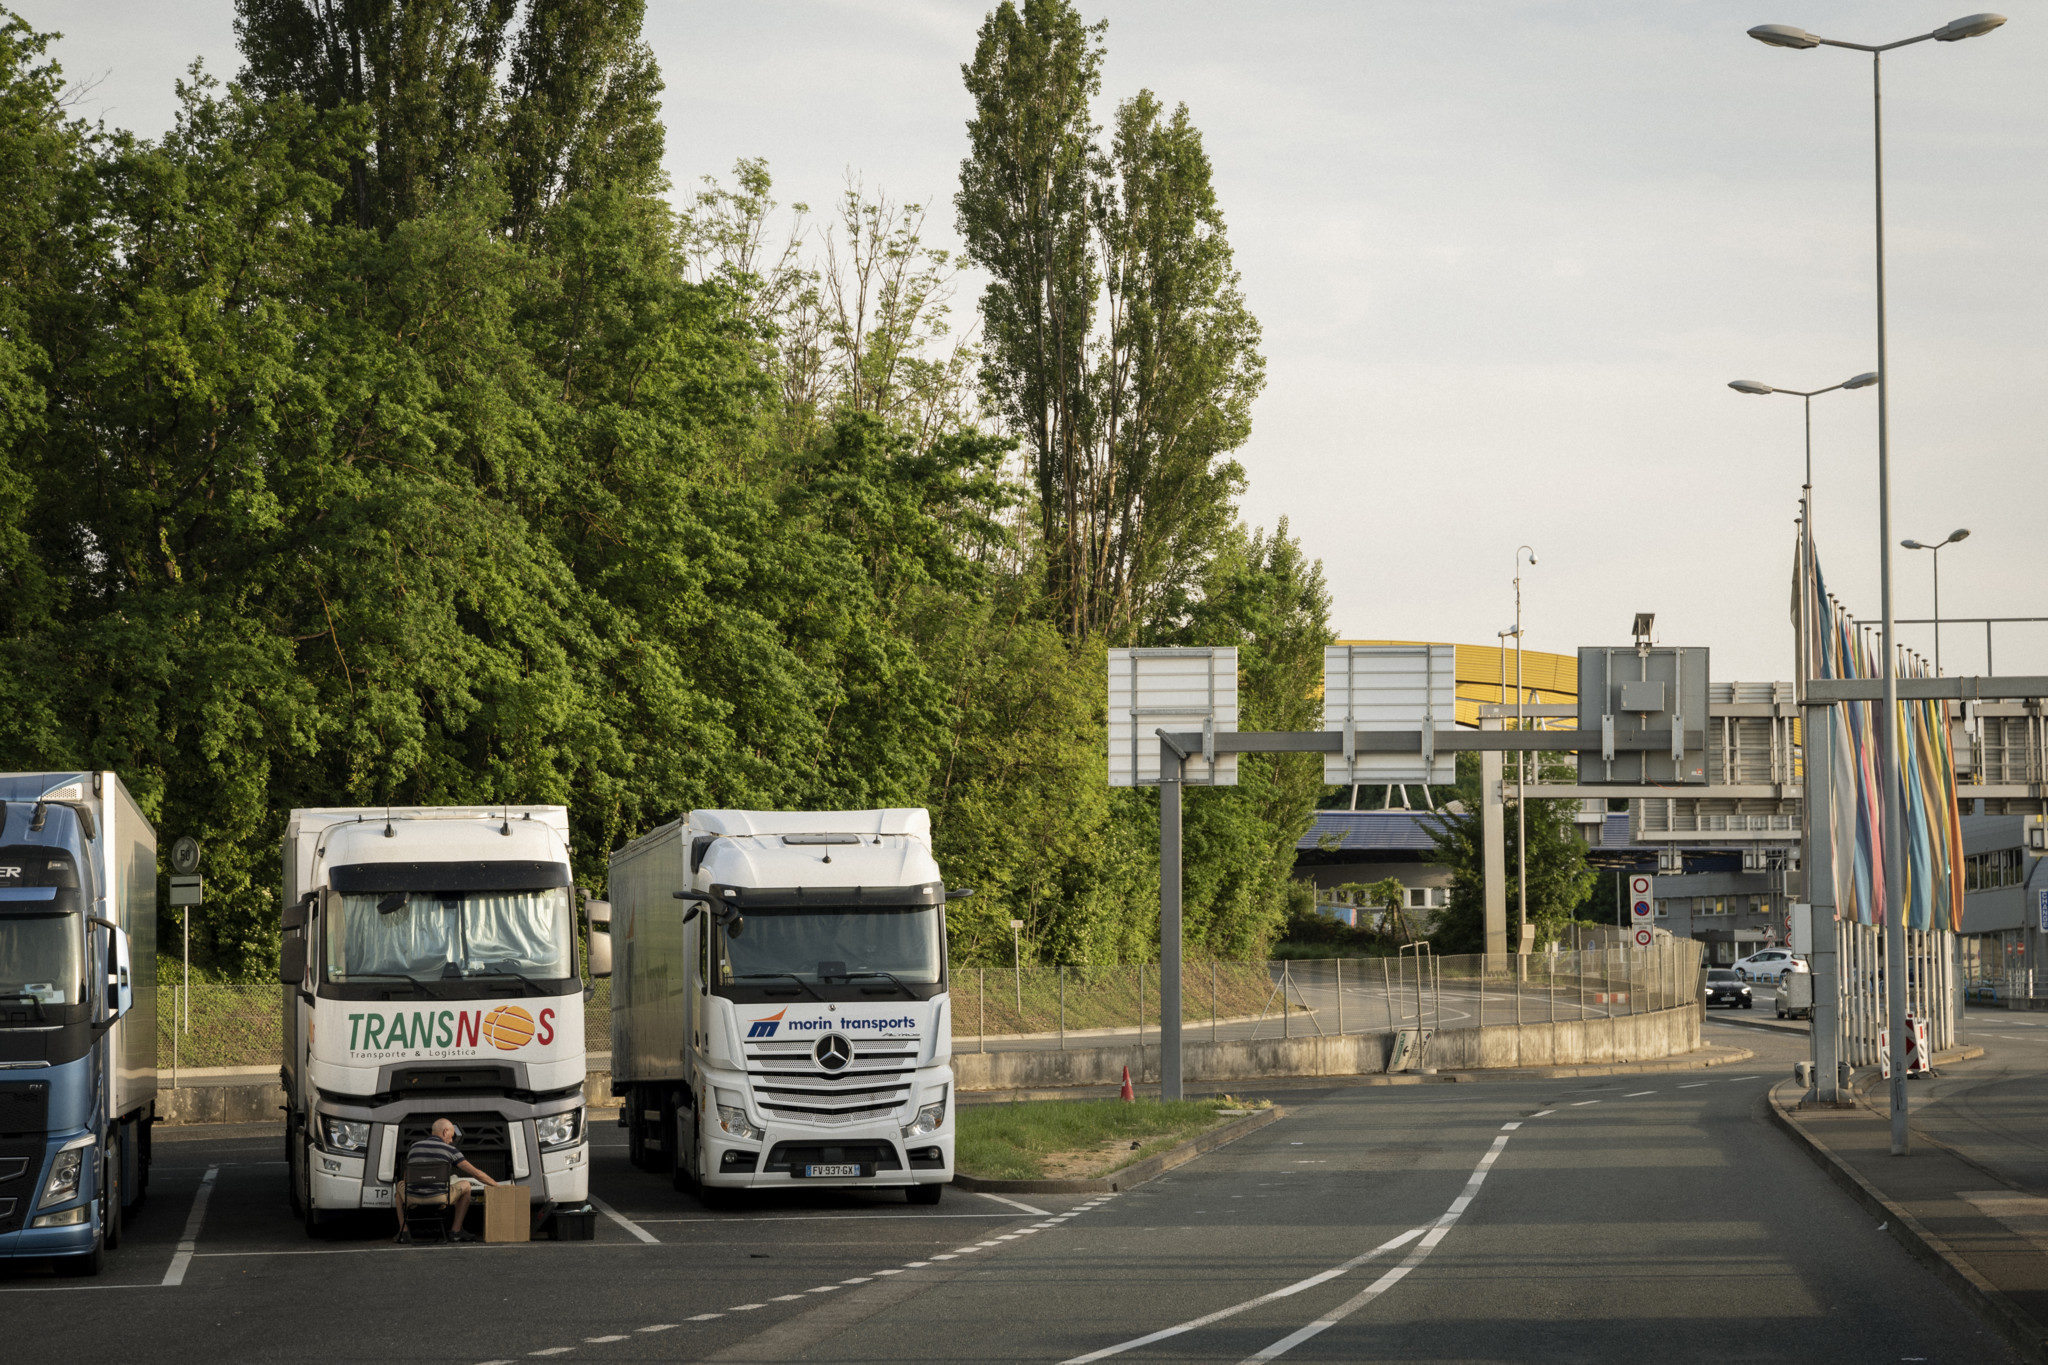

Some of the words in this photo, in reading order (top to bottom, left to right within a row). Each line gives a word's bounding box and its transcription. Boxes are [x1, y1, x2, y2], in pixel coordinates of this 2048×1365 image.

[789, 1016, 832, 1030] morin
[841, 1016, 916, 1032] transports
[350, 1051, 406, 1060] Transporte
[812, 1165, 854, 1175] FV-937-GX
[374, 1189, 389, 1199] TP
